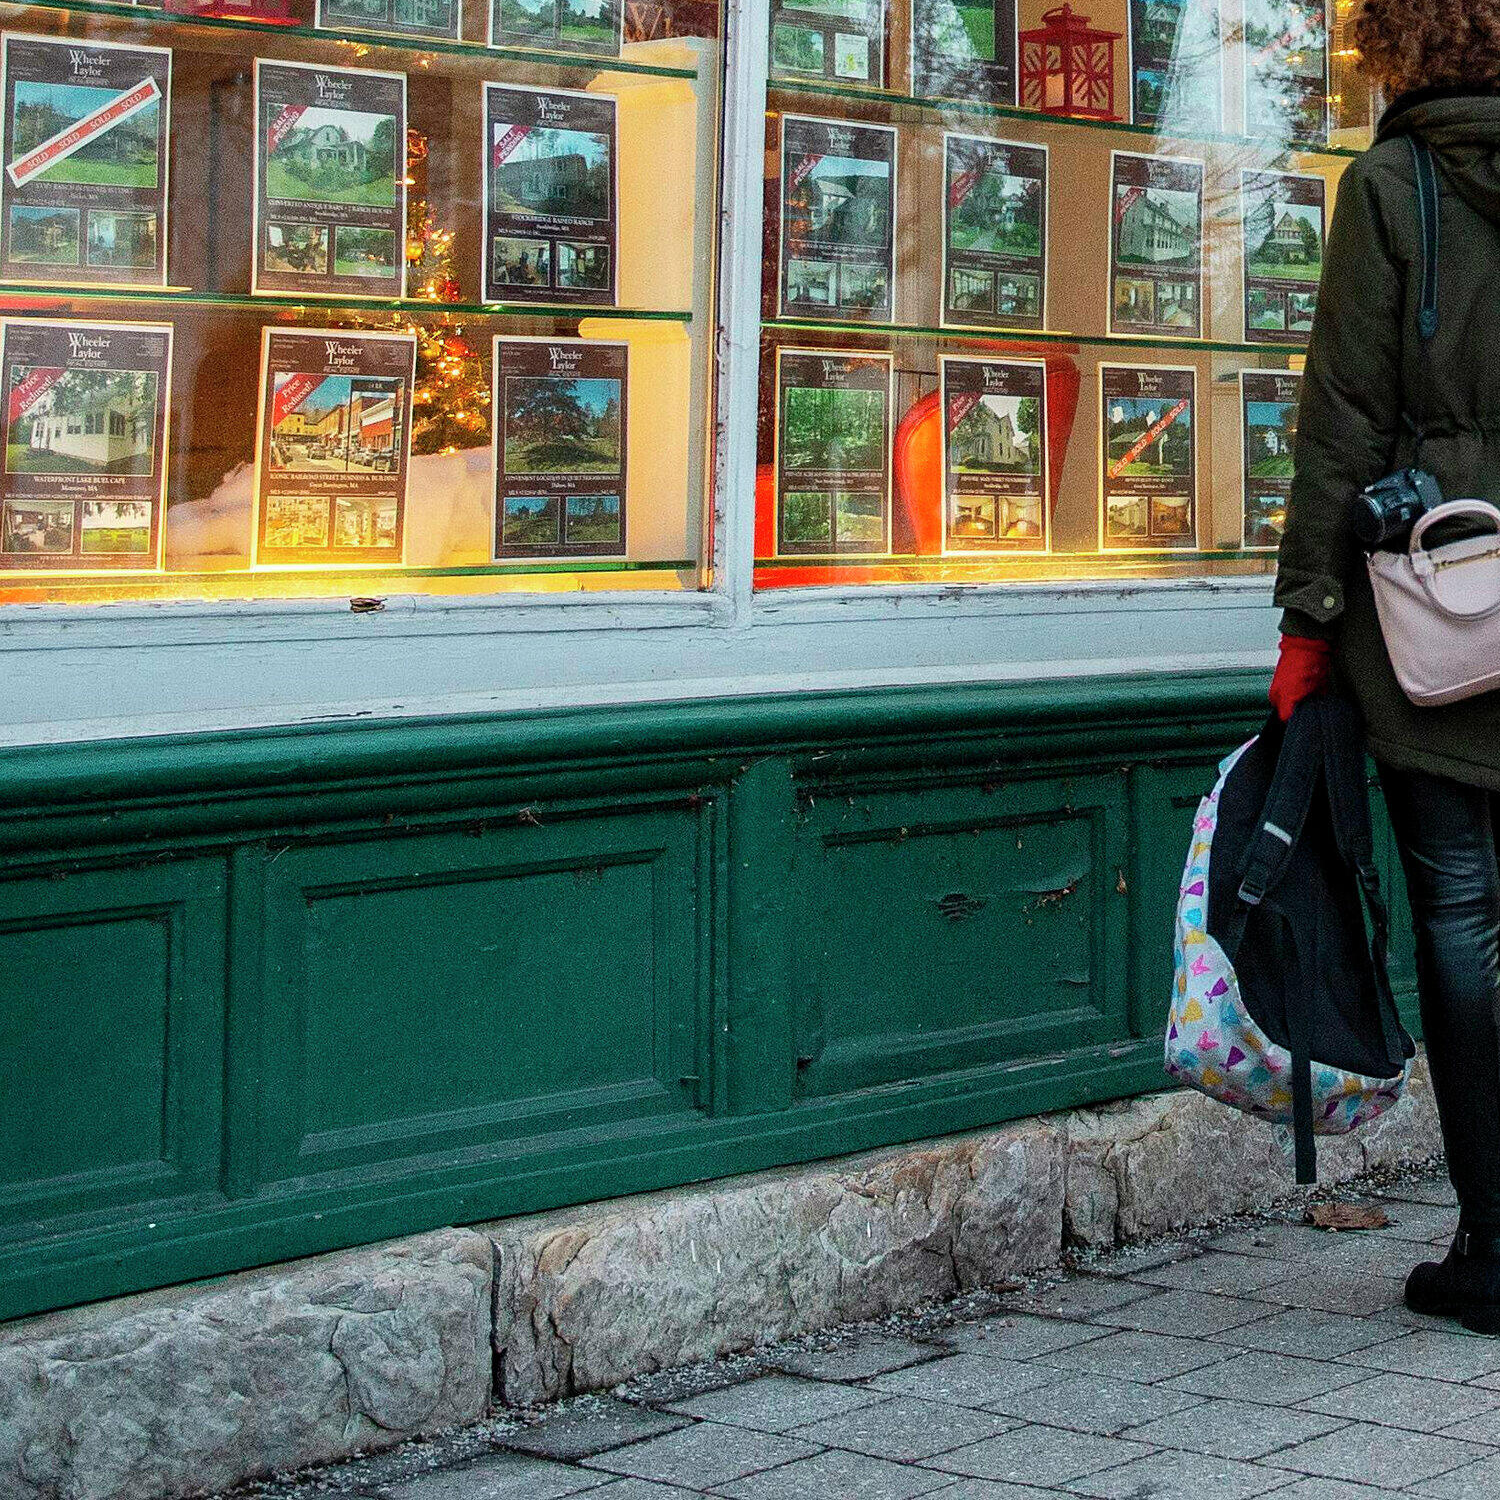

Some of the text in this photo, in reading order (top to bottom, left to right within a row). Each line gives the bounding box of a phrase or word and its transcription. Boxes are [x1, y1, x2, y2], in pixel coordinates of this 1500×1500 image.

[69, 49, 112, 67] Wheeler
[73, 63, 102, 79] Taylor
[315, 74, 352, 90] Wheeler
[319, 87, 344, 102] Taylor
[273, 111, 289, 130] SALE
[273, 112, 299, 144] PENDING
[27, 92, 142, 170] SOLD SOLD SOLD SOLD
[499, 131, 514, 148] SALE
[498, 132, 524, 160] PENDING
[68, 332, 111, 348] Wheeler
[325, 341, 363, 356] Wheeler
[71, 345, 101, 361] Taylor
[328, 353, 354, 367] Taylor
[548, 347, 583, 361] Wheeler
[19, 373, 39, 394] Price
[282, 379, 300, 399] Price
[19, 376, 52, 411] Reduced!
[281, 381, 314, 415] Reduced!
[1112, 401, 1185, 475] SOLD SOLD SOLD SOLD
[34, 476, 75, 484] WATERFRONT
